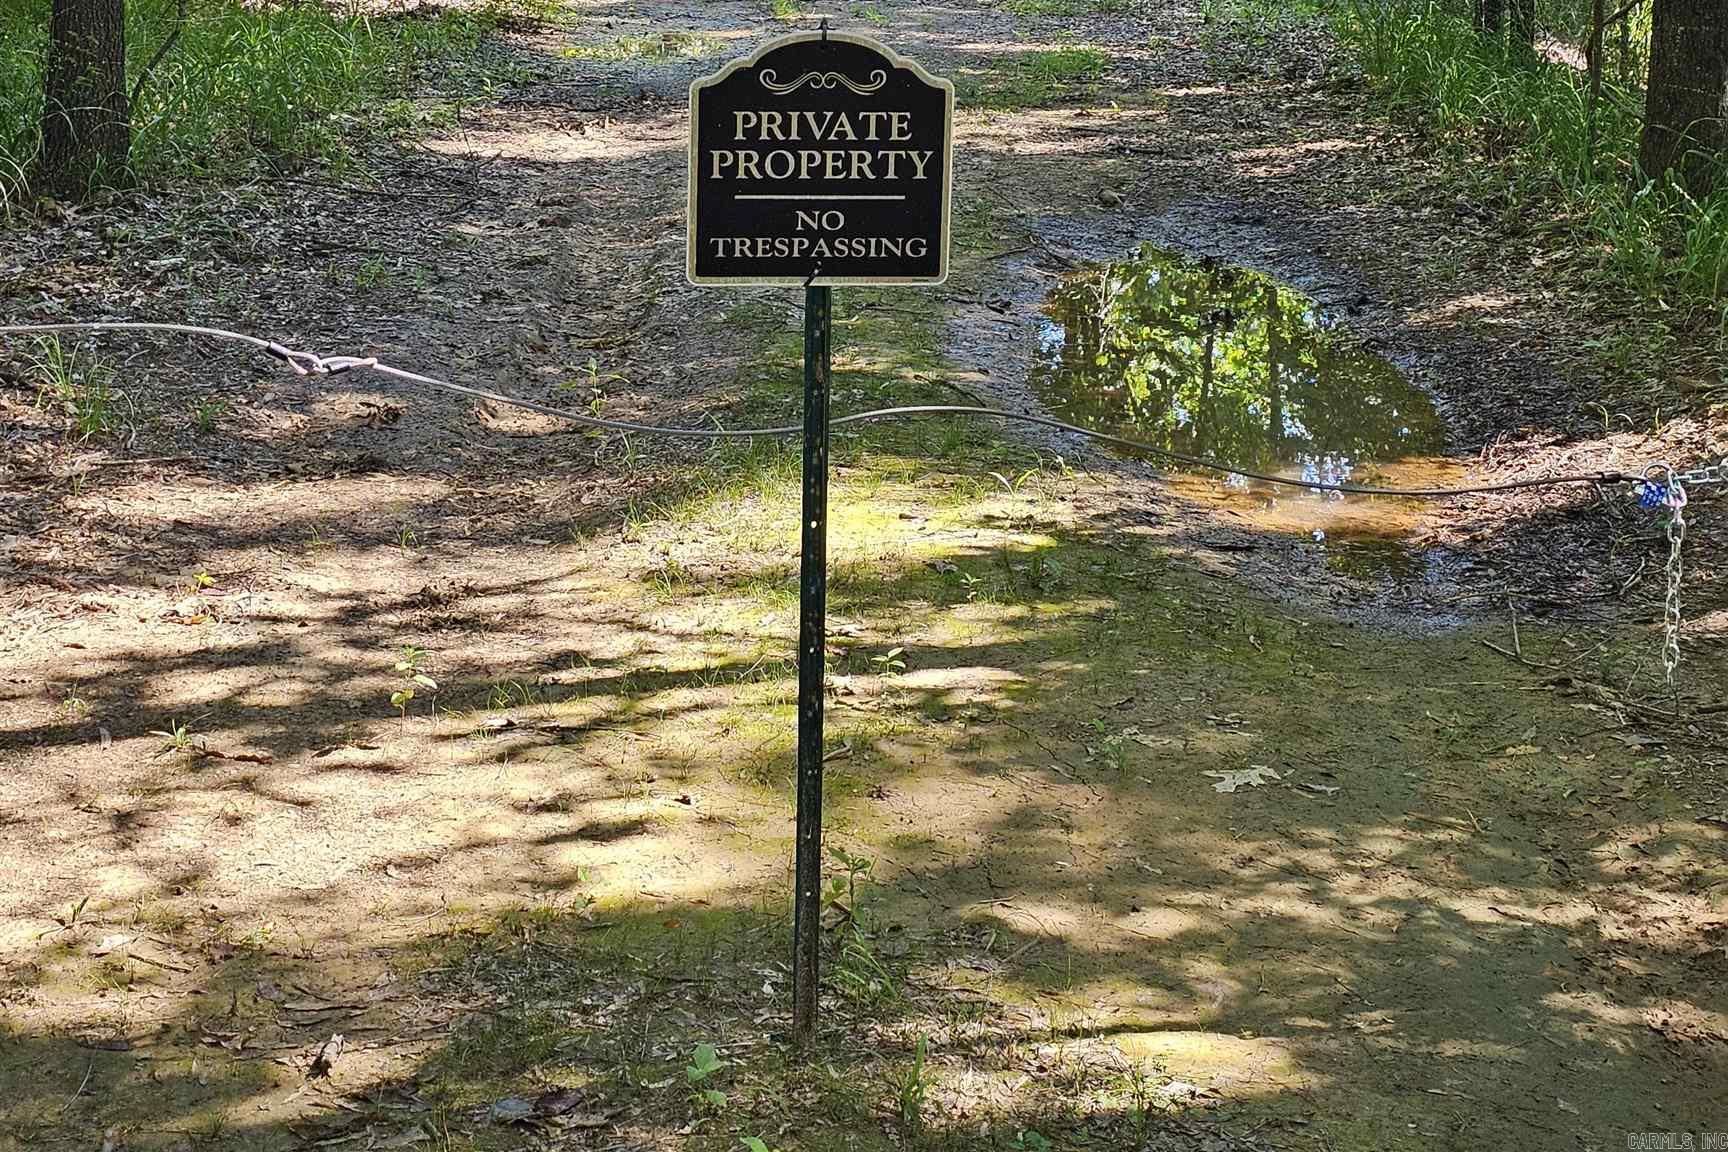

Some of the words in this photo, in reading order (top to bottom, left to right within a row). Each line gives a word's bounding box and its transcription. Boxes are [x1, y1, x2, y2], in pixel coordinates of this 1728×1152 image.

[733, 111, 912, 141] PRIVATE
[710, 150, 933, 179] PROPERTY
[795, 210, 845, 231] NO
[710, 237, 928, 258] TRESPASSING
